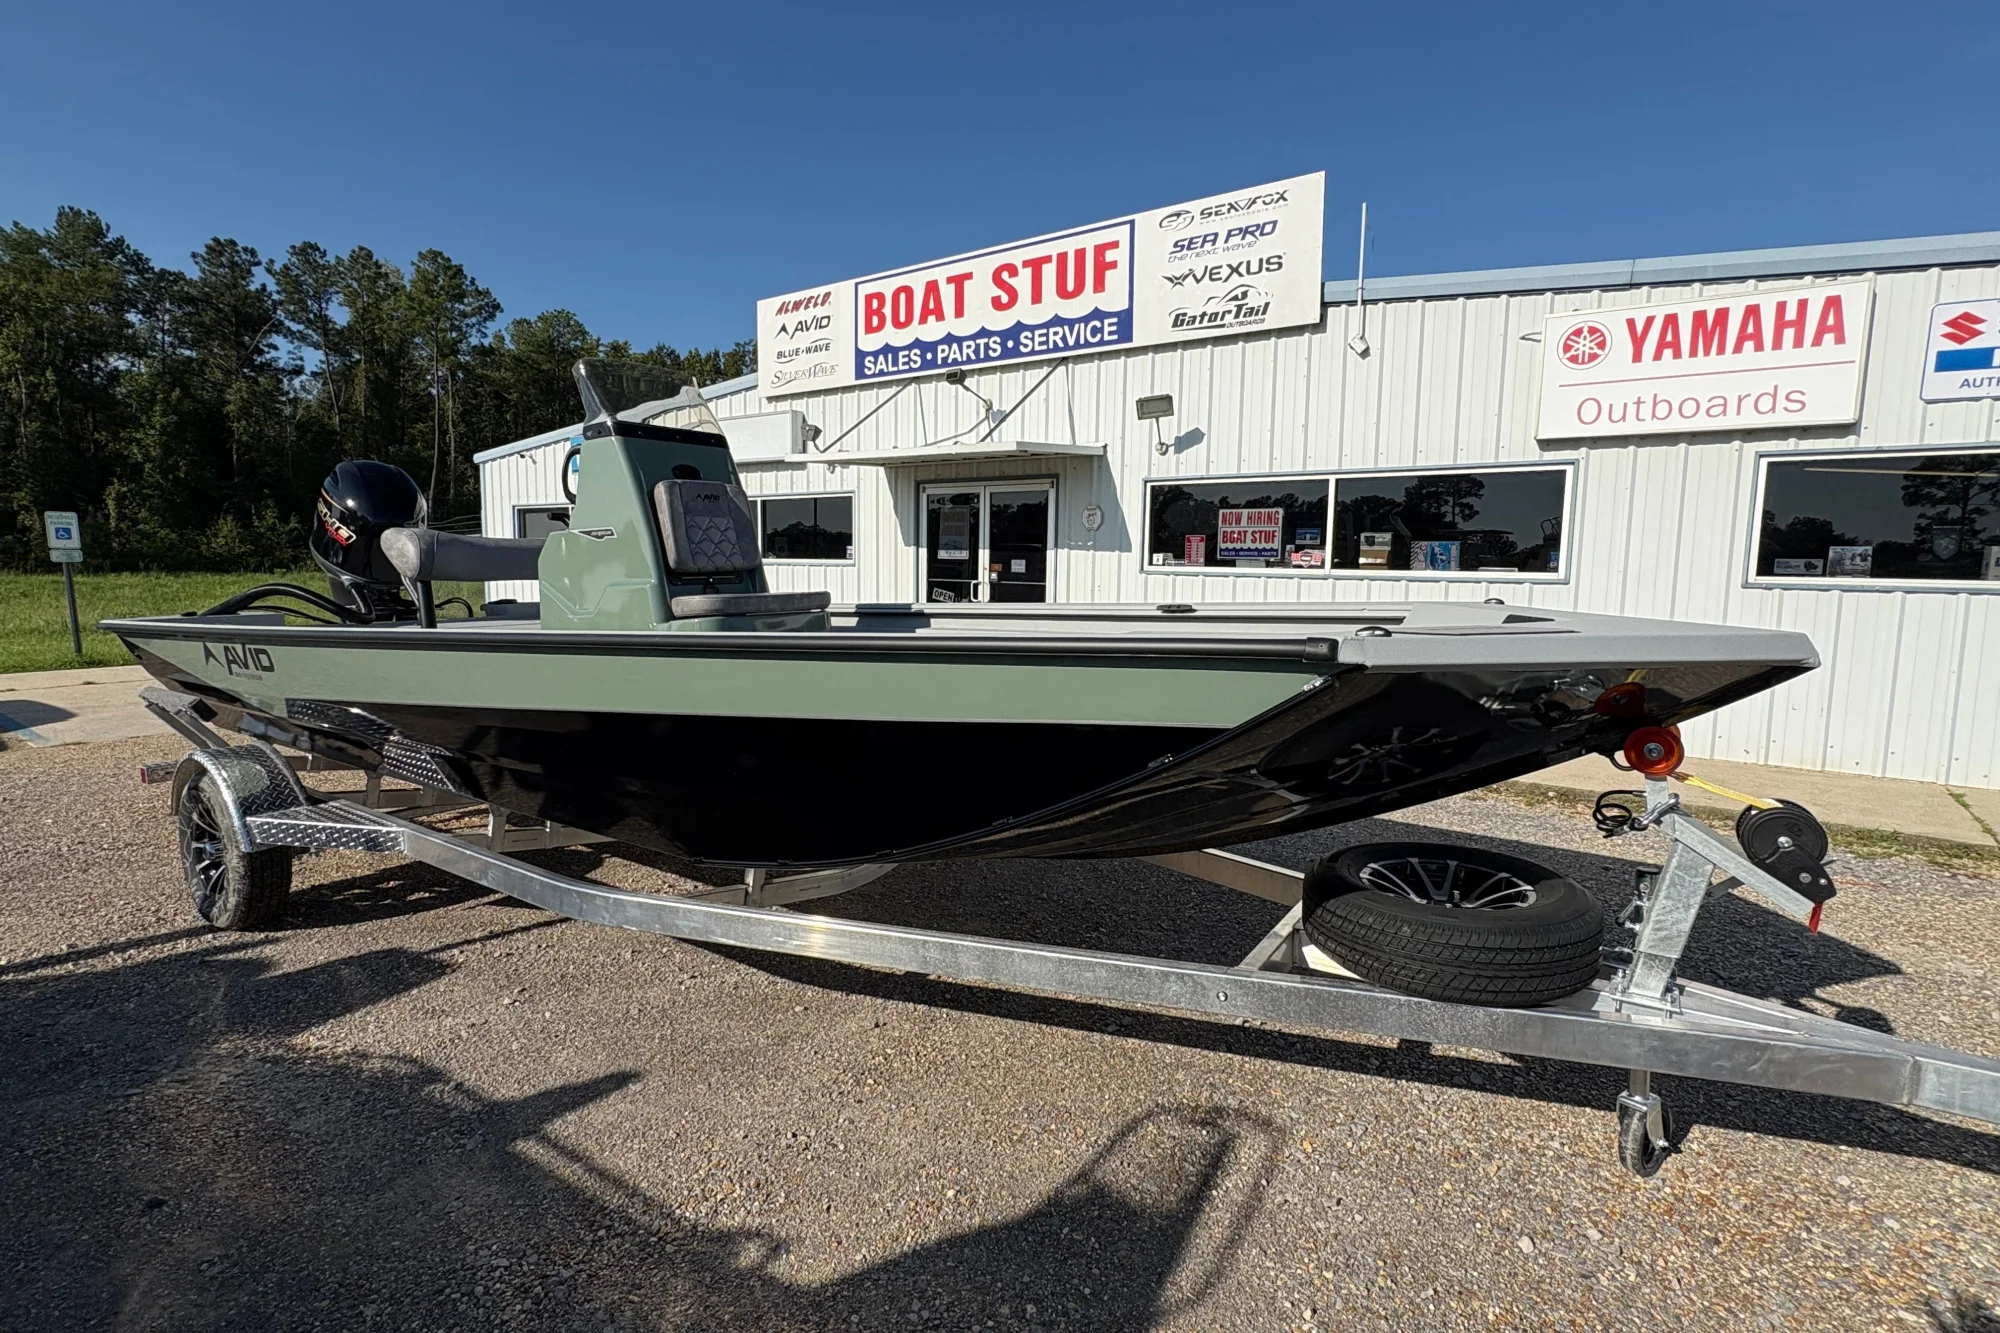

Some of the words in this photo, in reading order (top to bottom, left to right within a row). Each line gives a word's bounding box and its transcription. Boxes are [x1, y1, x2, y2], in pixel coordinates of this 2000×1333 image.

[1168, 231, 1220, 256] SEA
[1224, 219, 1279, 244] PRO
[1167, 251, 1188, 264] the
[1189, 246, 1220, 260] next
[1222, 240, 1258, 254] wave
[1191, 254, 1284, 285] VEXUS
[864, 270, 974, 336] BOAT
[990, 239, 1120, 312] STUF
[775, 291, 832, 317] ALWELD
[789, 314, 831, 340] AVID
[1226, 317, 1266, 329] OUTBOARDS
[1625, 294, 1847, 365] YAMAHA
[863, 348, 922, 375] SALES
[936, 335, 1002, 365] PARTS
[1018, 317, 1119, 353] SERVICE
[1576, 384, 1808, 426] Outboards
[1221, 511, 1243, 526] NOW
[1246, 510, 1280, 526] HIRING
[1221, 530, 1248, 545] BOAT
[1250, 529, 1278, 545] STUF
[933, 589, 954, 601] OPEN
[223, 642, 276, 676] AVID
